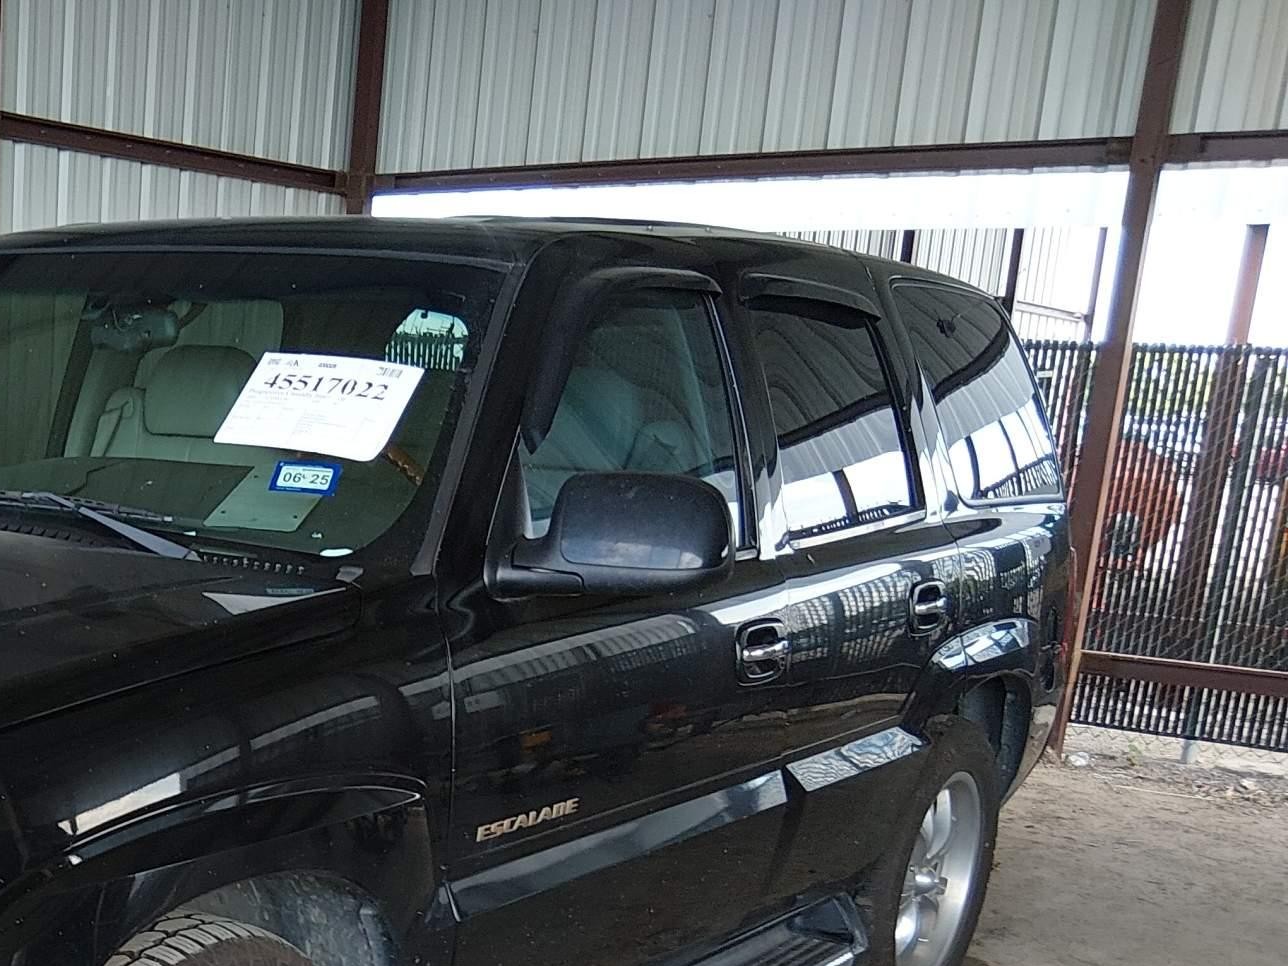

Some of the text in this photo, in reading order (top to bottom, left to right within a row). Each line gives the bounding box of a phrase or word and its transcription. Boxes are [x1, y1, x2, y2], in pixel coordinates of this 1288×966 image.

[264, 372, 389, 401] 45517022
[282, 471, 330, 486] 06 25
[476, 797, 580, 842] ESCALADE
